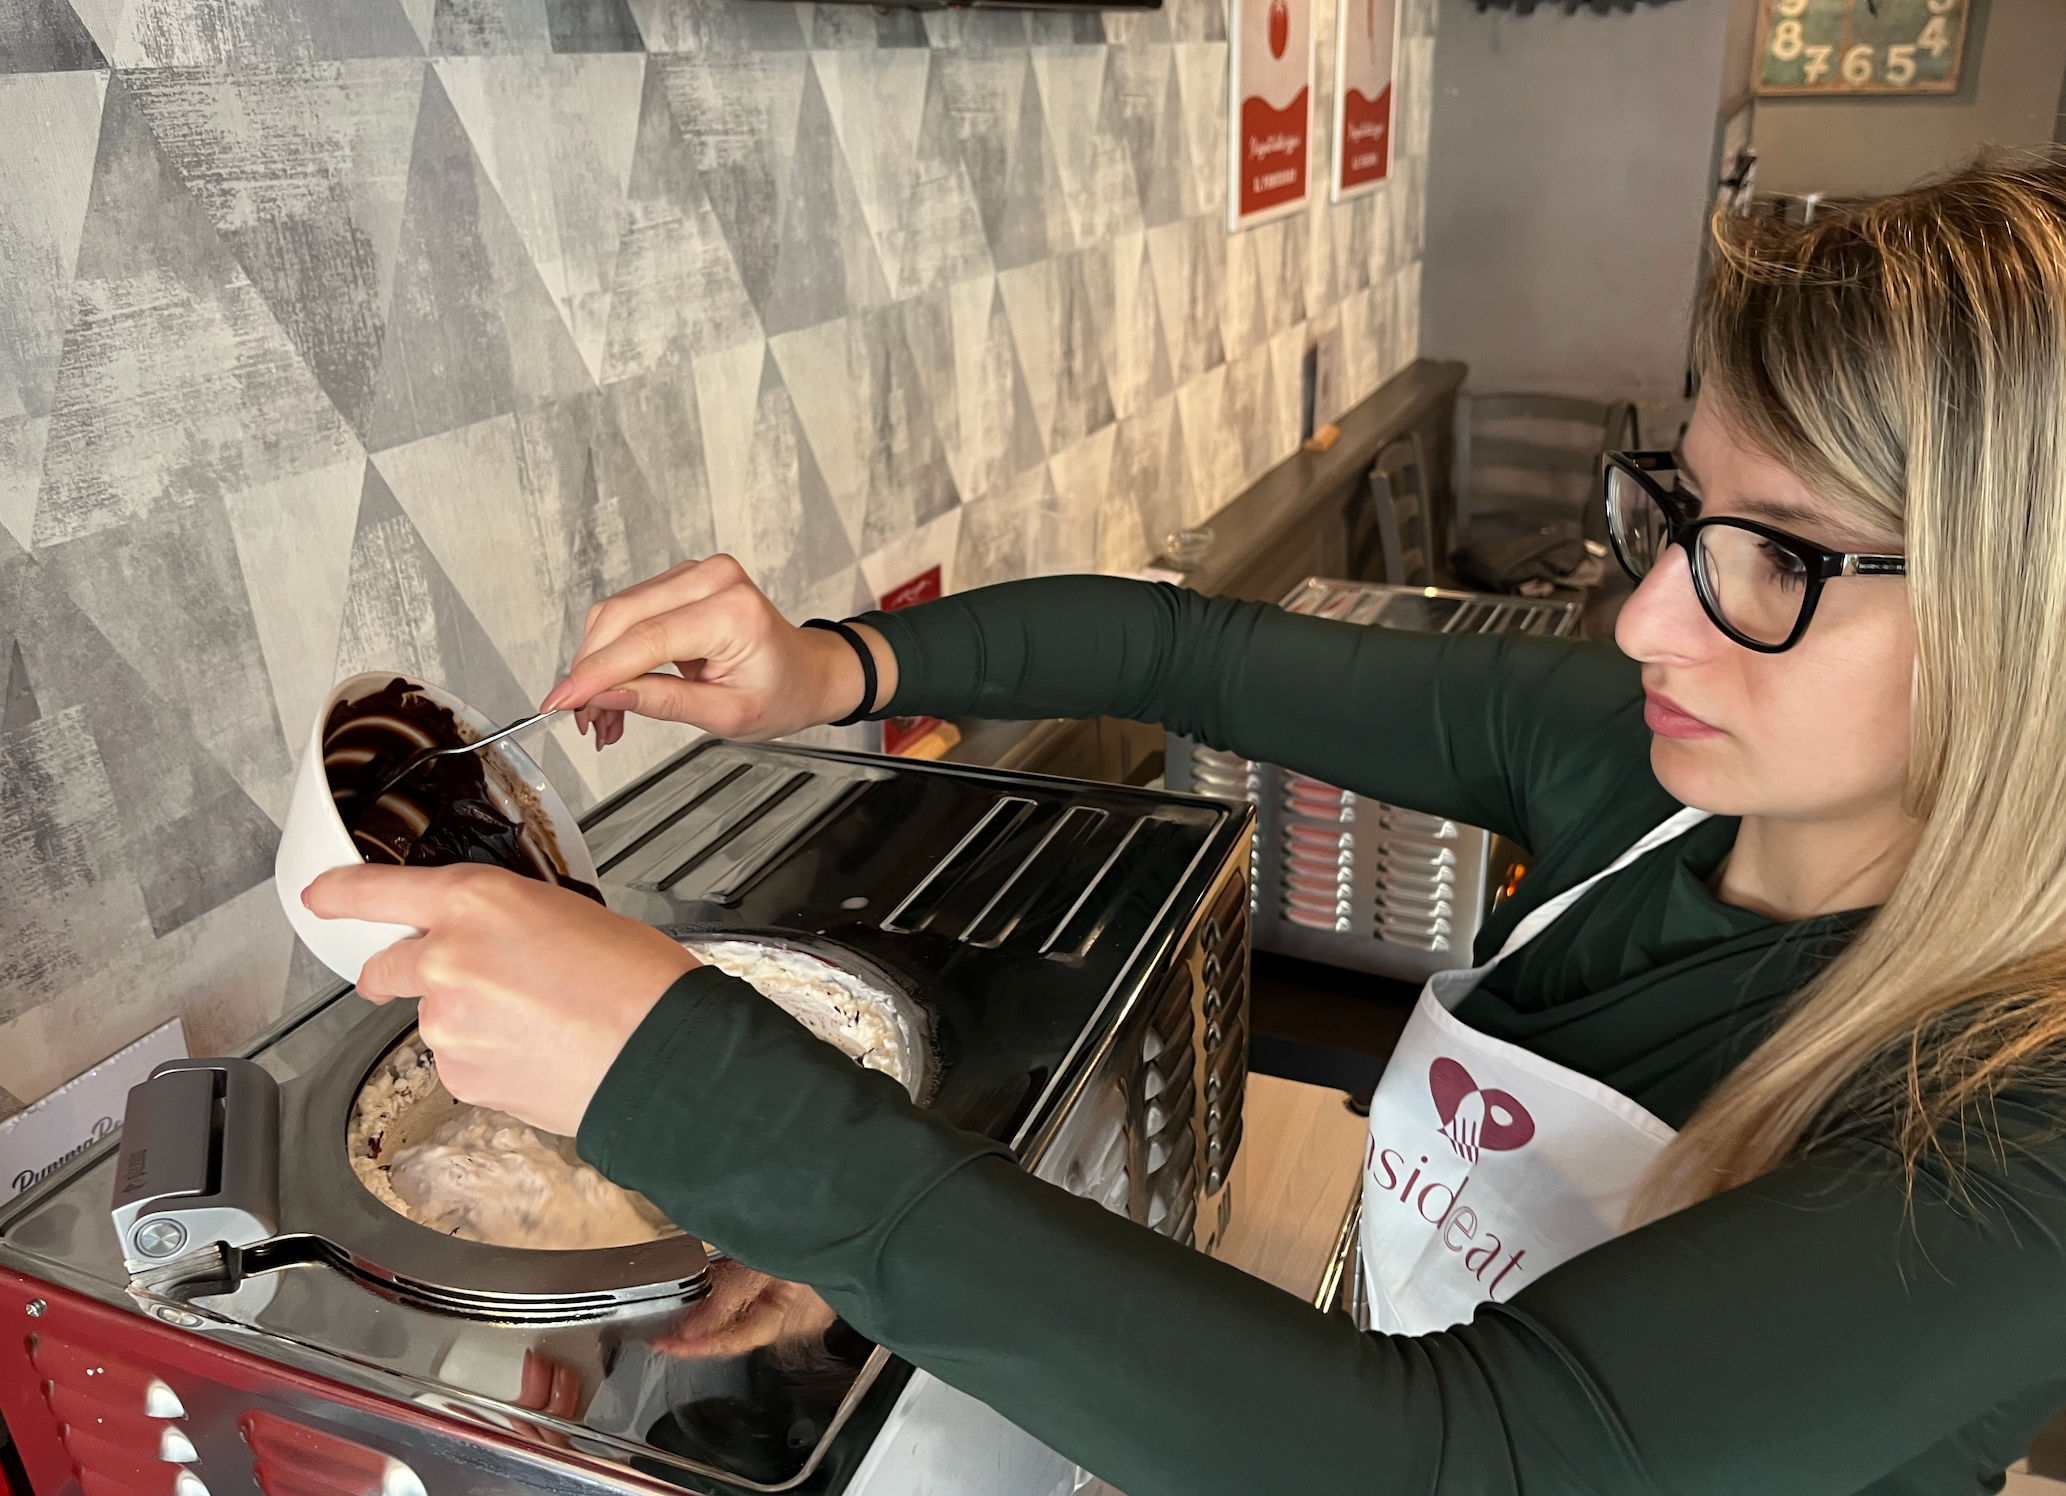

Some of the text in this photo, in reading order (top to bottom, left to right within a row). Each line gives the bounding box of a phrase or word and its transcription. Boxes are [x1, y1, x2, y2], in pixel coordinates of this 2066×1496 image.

[1773, 18, 1803, 61] 8
[1917, 15, 1948, 58] 4
[1804, 45, 1833, 84] 7
[1841, 43, 1875, 85] 6
[1885, 44, 1916, 86] 5
